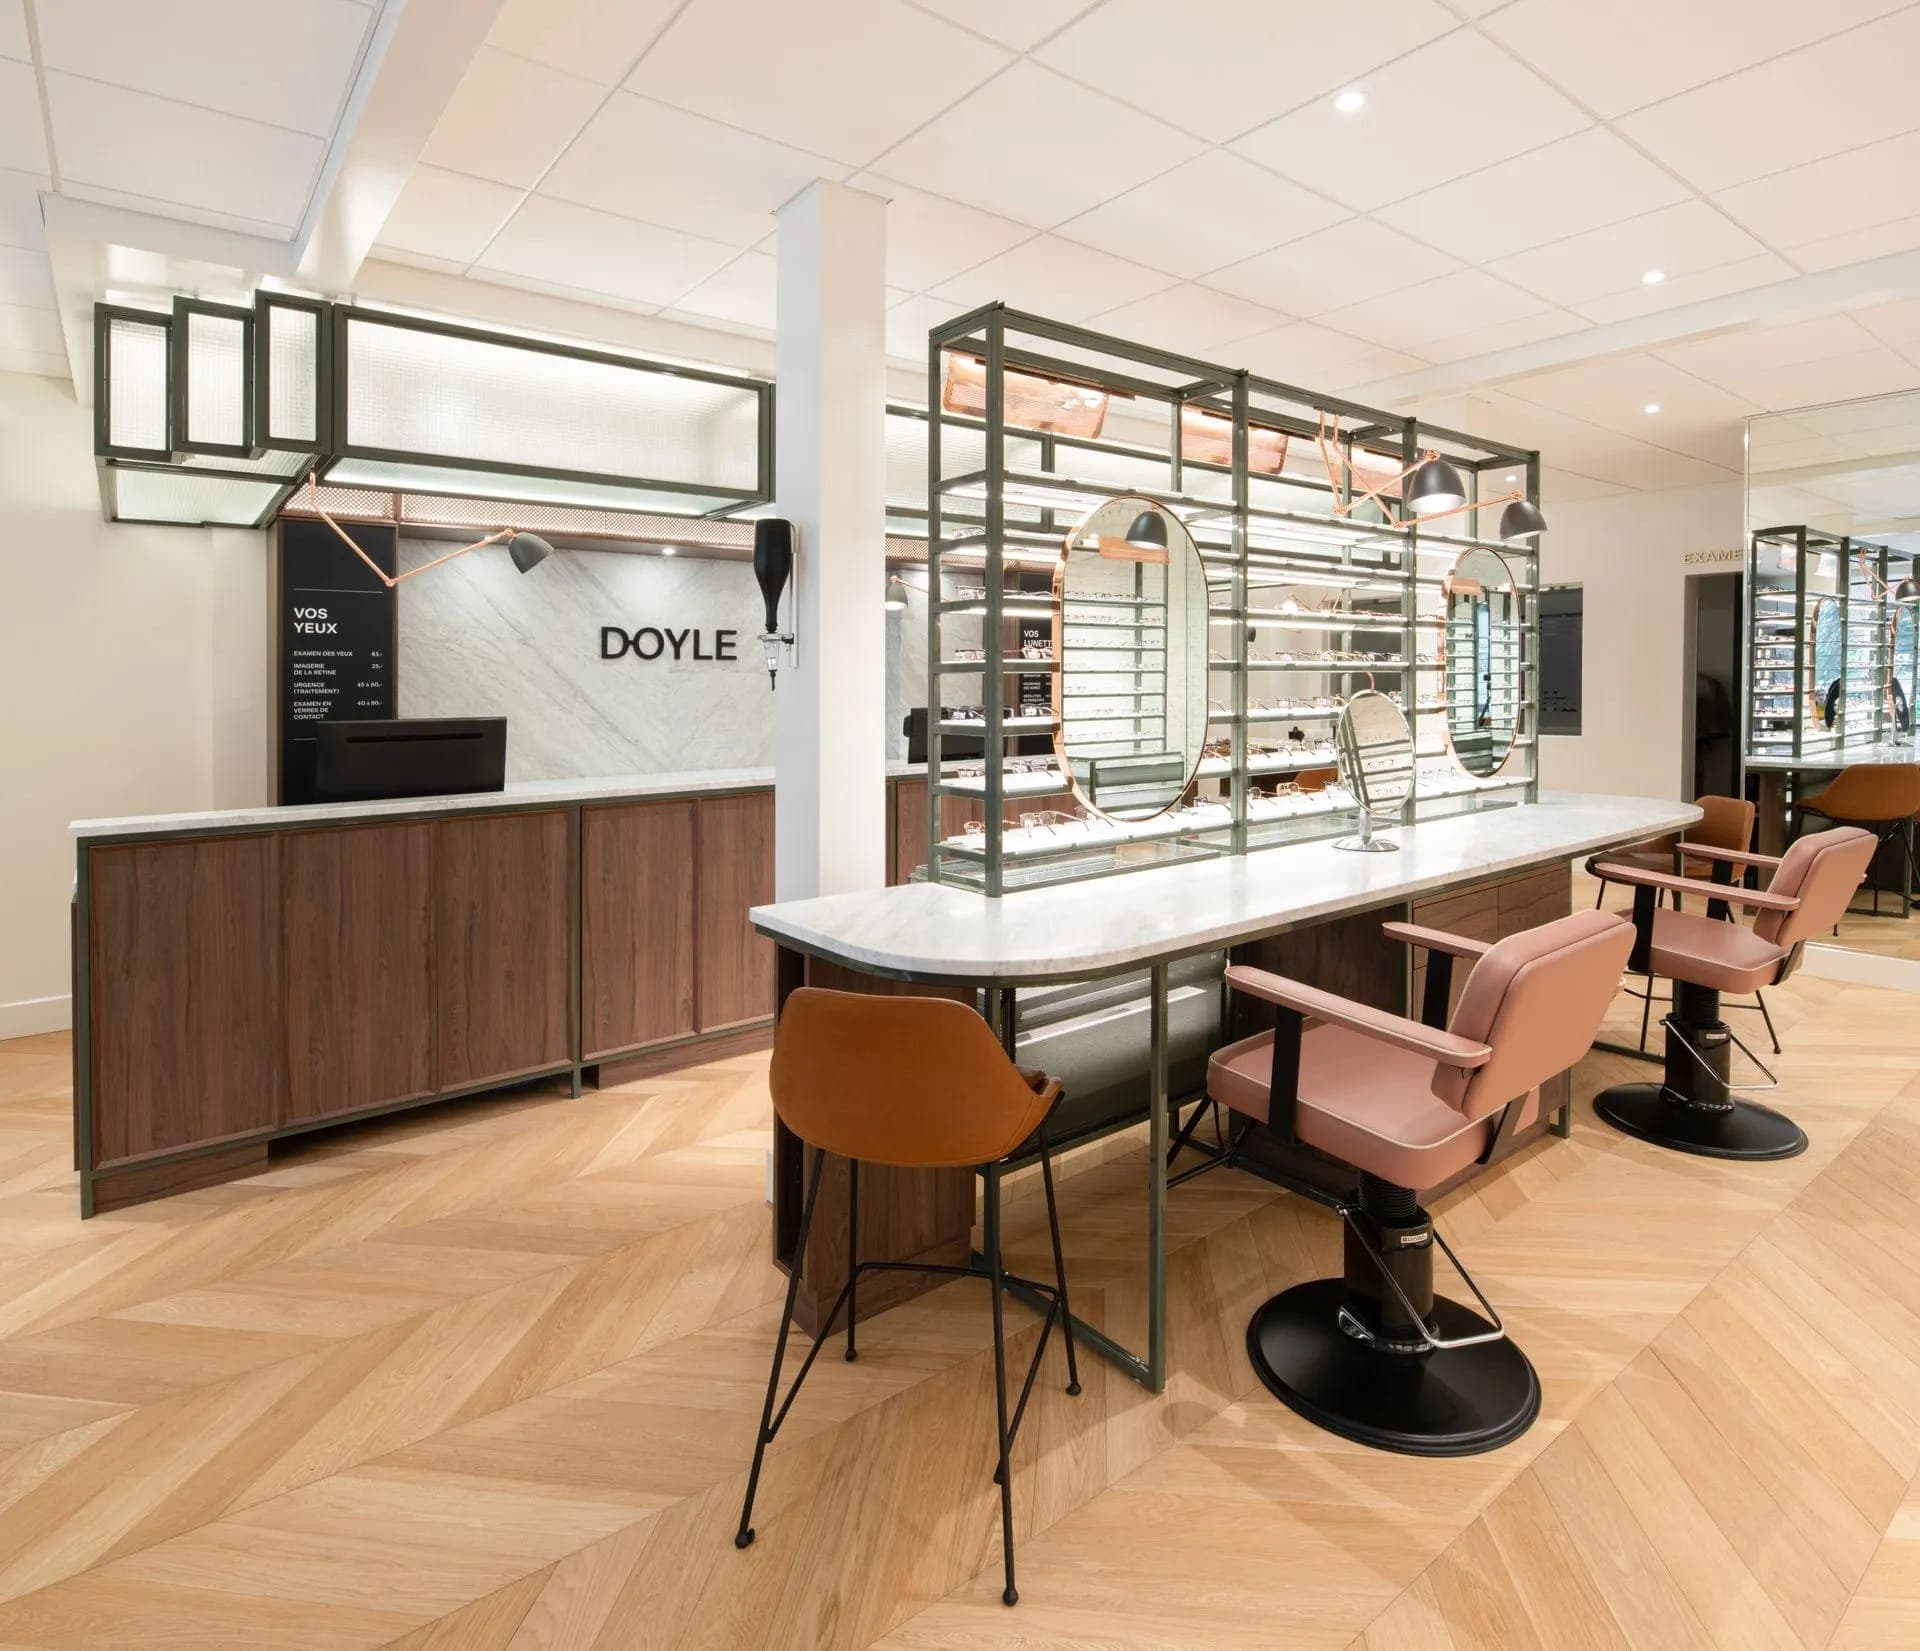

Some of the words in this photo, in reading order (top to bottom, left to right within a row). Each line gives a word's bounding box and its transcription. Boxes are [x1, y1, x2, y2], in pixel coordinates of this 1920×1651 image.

[293, 607, 329, 620] VOS
[293, 622, 338, 634] YEUX
[1023, 629, 1040, 638] VOS
[600, 626, 738, 661] DOYLE
